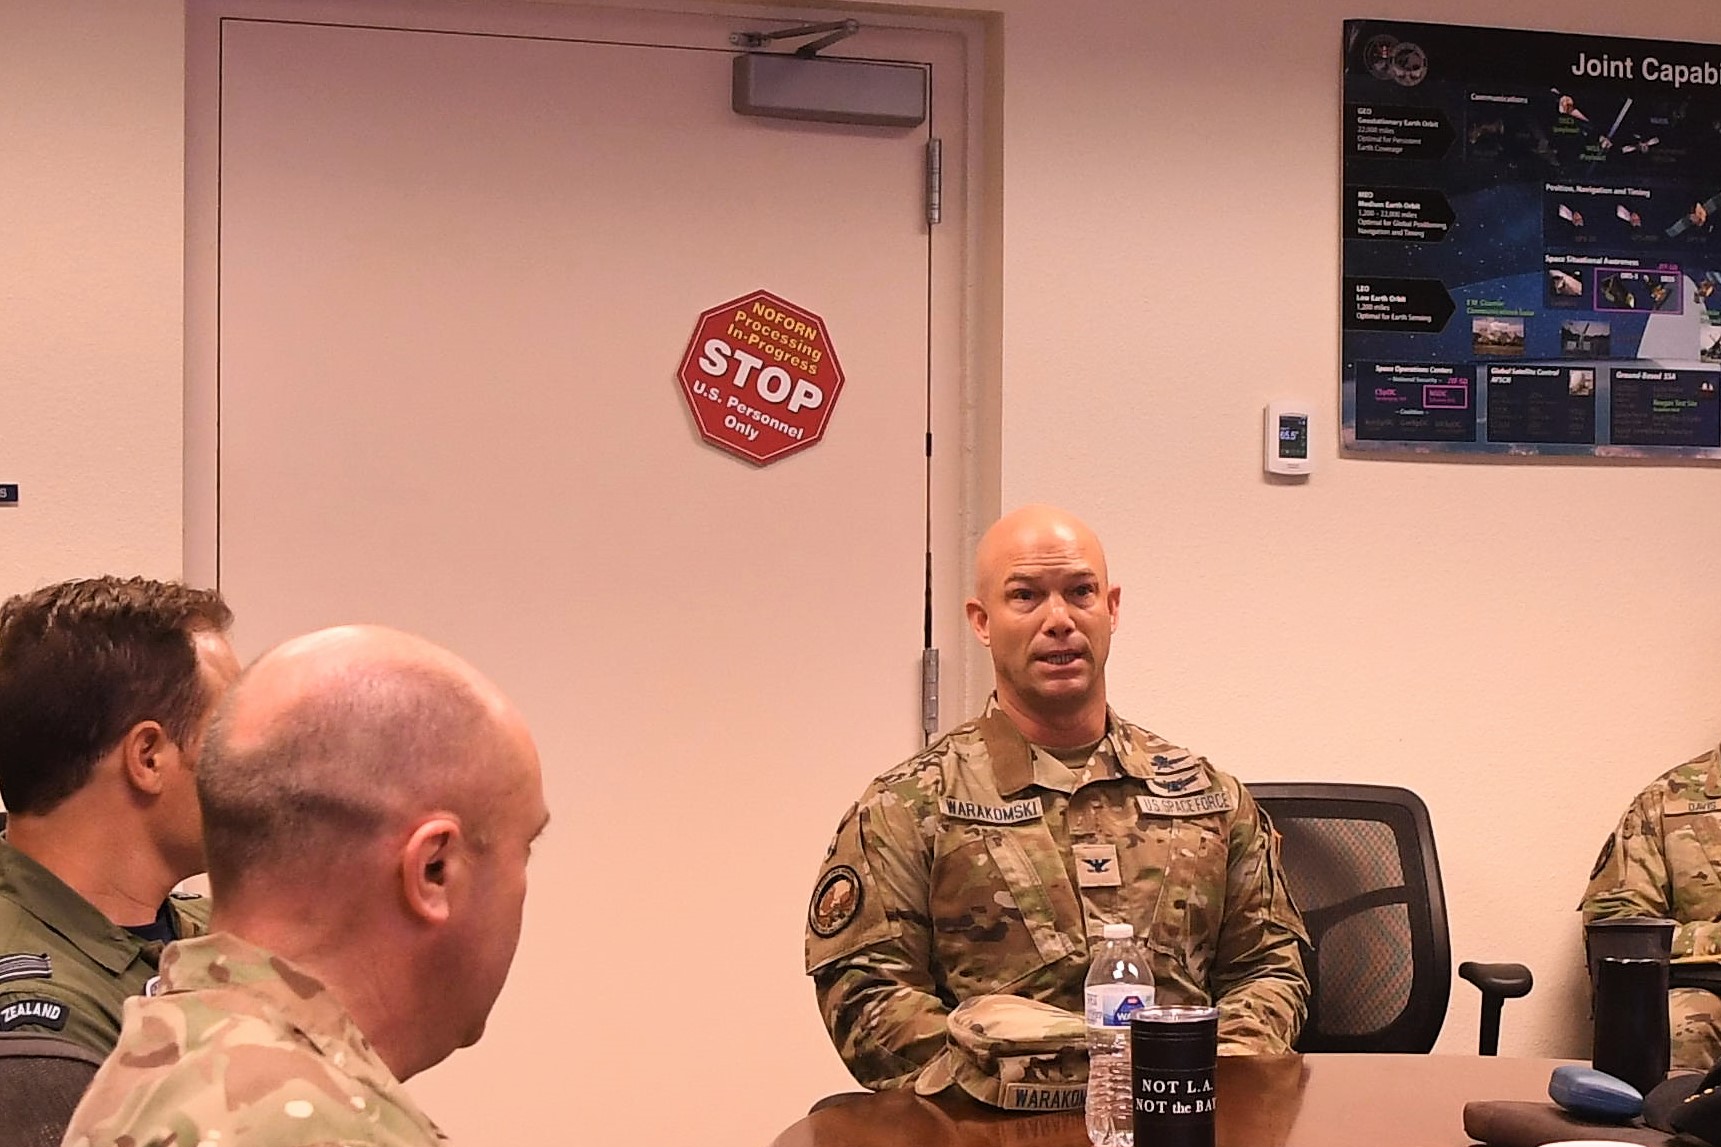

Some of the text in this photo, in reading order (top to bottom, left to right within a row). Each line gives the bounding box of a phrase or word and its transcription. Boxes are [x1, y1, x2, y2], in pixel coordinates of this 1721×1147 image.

[1572, 53, 1633, 79] Joint
[1422, 120, 1438, 128] Orbit
[1576, 186, 1612, 195] Navigation
[1627, 188, 1650, 198] Timing
[1404, 230, 1425, 238] Timing
[1545, 255, 1565, 263] Space
[1389, 295, 1406, 303] Orbit
[753, 302, 817, 340] NOFORN
[1409, 314, 1431, 323] Sensing
[735, 311, 822, 361] Processing
[727, 323, 817, 375] In-Progress
[699, 339, 823, 413] STOP
[1375, 365, 1393, 373] Space
[1395, 366, 1428, 374] Operations
[693, 380, 804, 440] U.S. Personnel
[724, 416, 759, 440] Only
[946, 800, 1037, 820] WARAKOMSKI
[1162, 800, 1195, 812] SPACE
[1196, 793, 1230, 811] FORCE
[1688, 802, 1716, 811] DAVIS
[0, 1002, 61, 1023] ZEALAND
[1142, 1079, 1213, 1093] NOT L.A.
[1136, 1098, 1167, 1113] NOT
[1173, 1102, 1191, 1114] the
